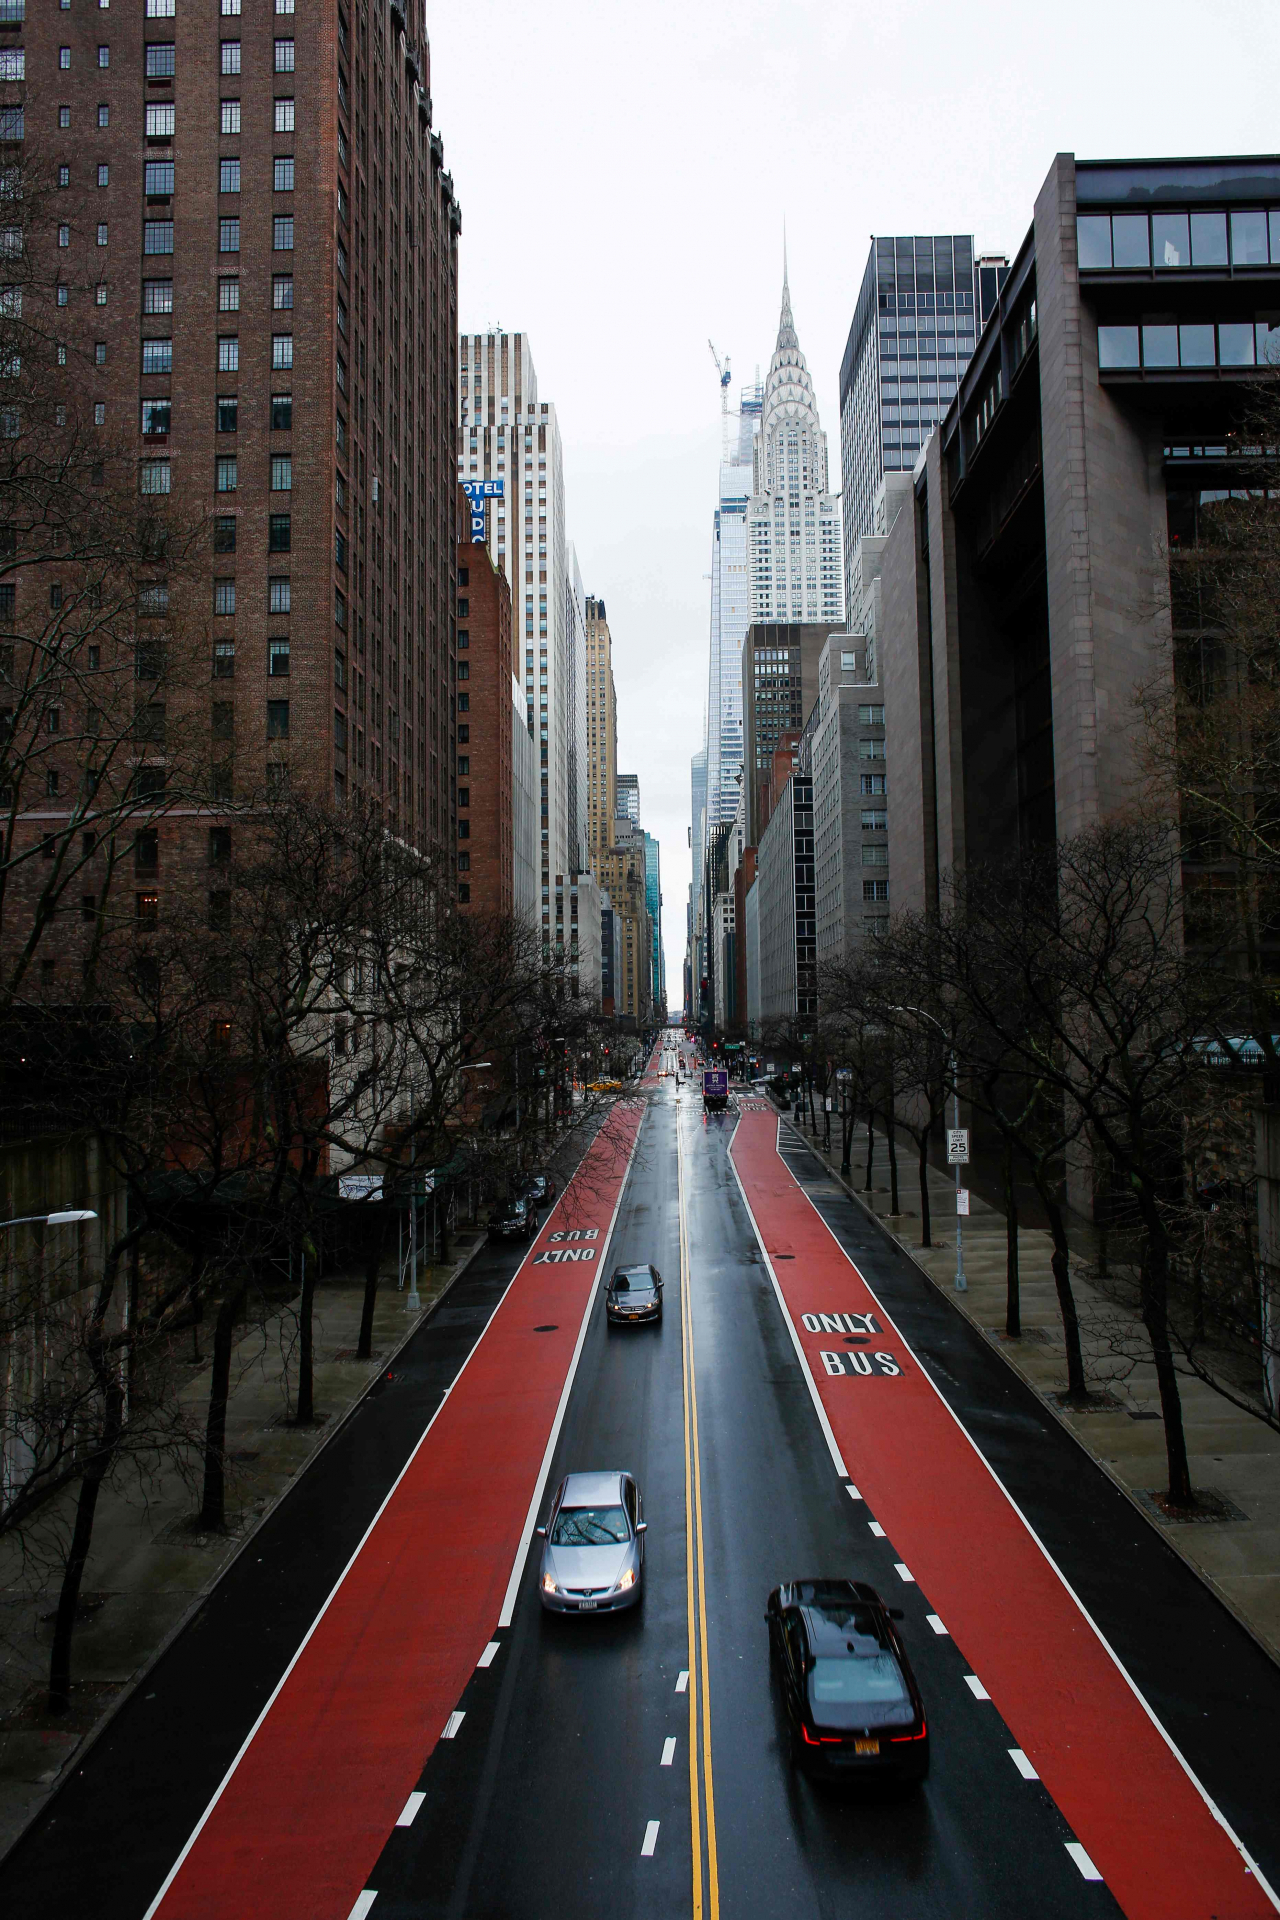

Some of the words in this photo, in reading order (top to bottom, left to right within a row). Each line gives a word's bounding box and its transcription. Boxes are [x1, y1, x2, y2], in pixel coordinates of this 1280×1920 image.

[463, 482, 502, 495] OTEL
[951, 1143, 966, 1152] 25
[550, 1228, 600, 1242] BUS
[533, 1248, 595, 1265] ONLY
[801, 1313, 876, 1333] ONLY
[819, 1351, 900, 1376] BUS
